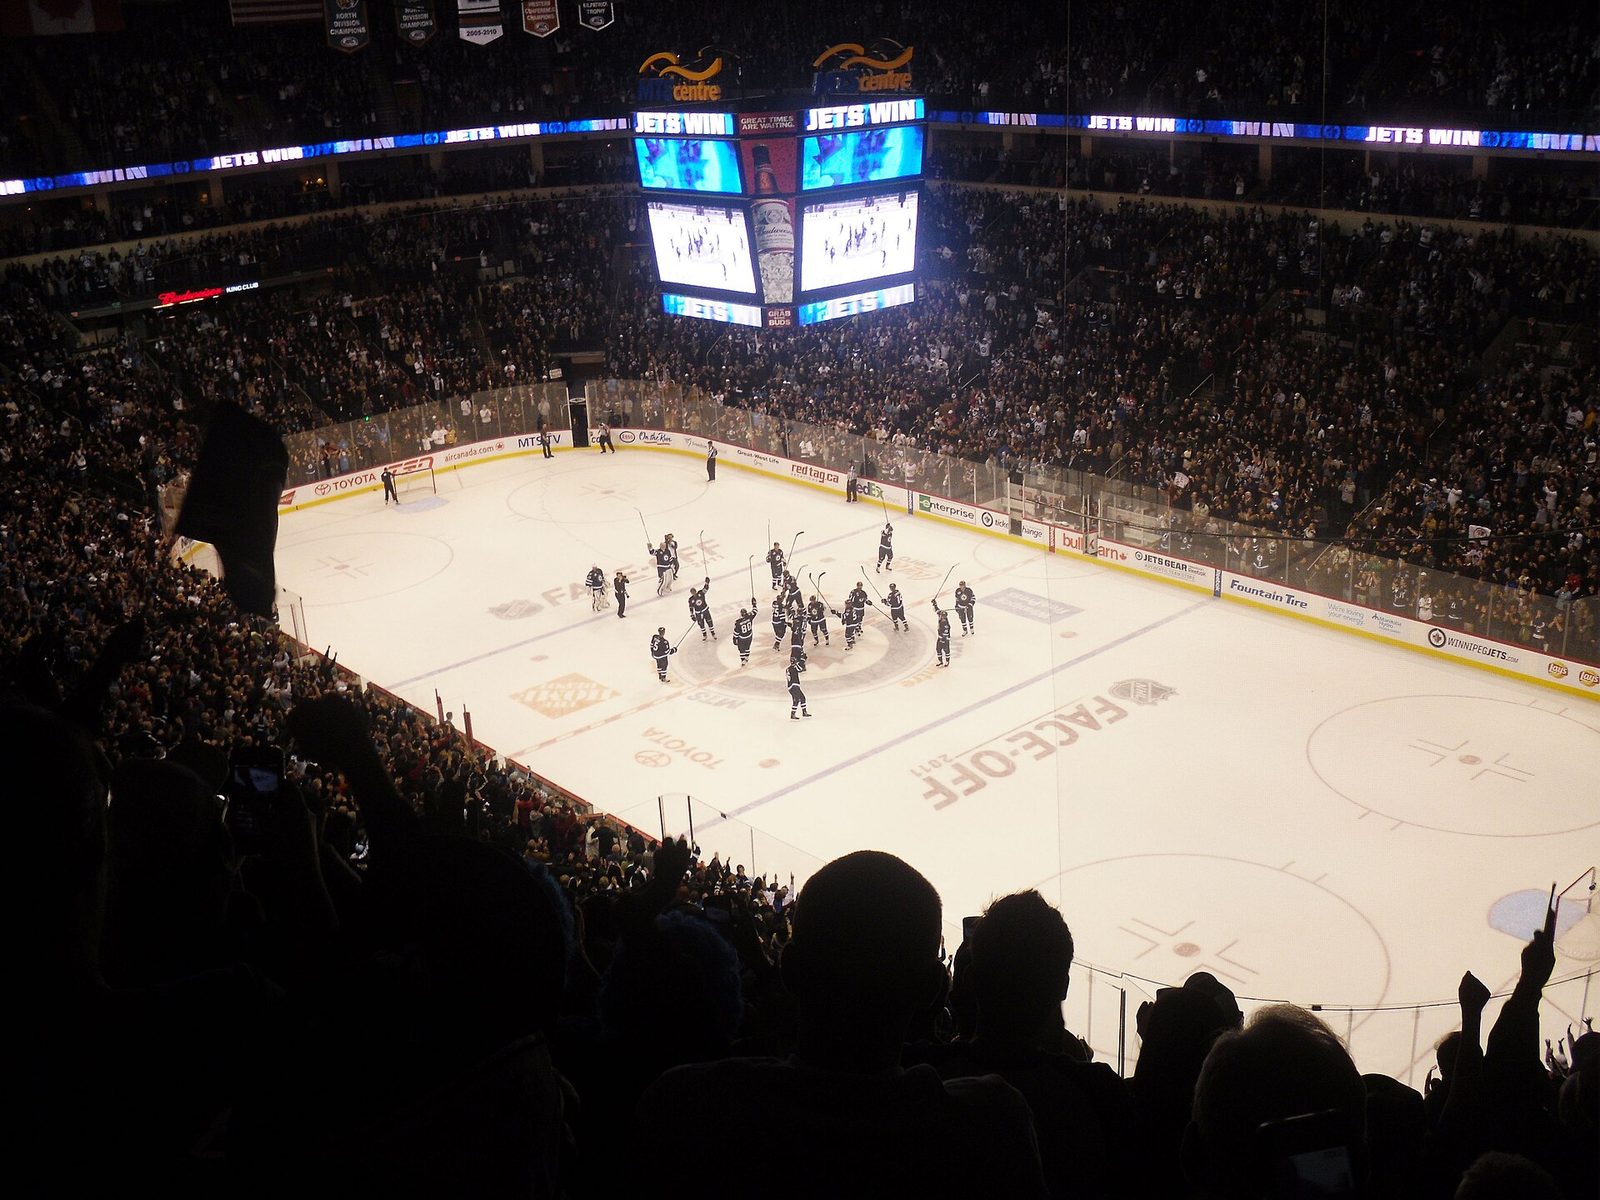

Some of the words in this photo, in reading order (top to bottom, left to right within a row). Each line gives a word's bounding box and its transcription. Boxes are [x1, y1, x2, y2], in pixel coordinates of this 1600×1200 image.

[333, 19, 361, 28] DIVISION
[335, 11, 358, 20] NORTH
[400, 19, 434, 30] CHAMPIONS
[402, 12, 429, 21] DIVISION
[329, 26, 367, 37] CHAMPIONS
[466, 28, 498, 38] 2005-2010
[671, 81, 721, 102] centre
[635, 112, 681, 134] JETS
[682, 113, 725, 134] WIN
[768, 115, 793, 123] TIMES
[806, 105, 864, 131] JETS
[867, 99, 914, 124] WIN
[1087, 114, 1132, 131] JETS
[1135, 116, 1175, 133] WIN
[444, 126, 494, 142] JETS
[497, 123, 540, 137] WIN
[759, 121, 795, 129] WAITING.
[1364, 126, 1423, 144] JETS
[1427, 128, 1480, 147] WIN
[210, 151, 258, 170] JETS
[261, 146, 304, 162] WIN
[225, 285, 242, 298] KING
[242, 281, 260, 294] CLUB
[444, 445, 494, 463] aircanada.com
[791, 464, 808, 475] red
[333, 473, 377, 490] TOYOTA
[857, 481, 883, 498] edEx
[919, 499, 974, 521] enterprise
[1144, 554, 1164, 566] JETS
[1164, 559, 1188, 577] GEAR
[1230, 579, 1283, 602] Fountain
[1285, 593, 1308, 609] Tire
[641, 726, 725, 771] TOYOTA
[919, 695, 1129, 812] FACE-OFF
[910, 752, 954, 778] 2011
